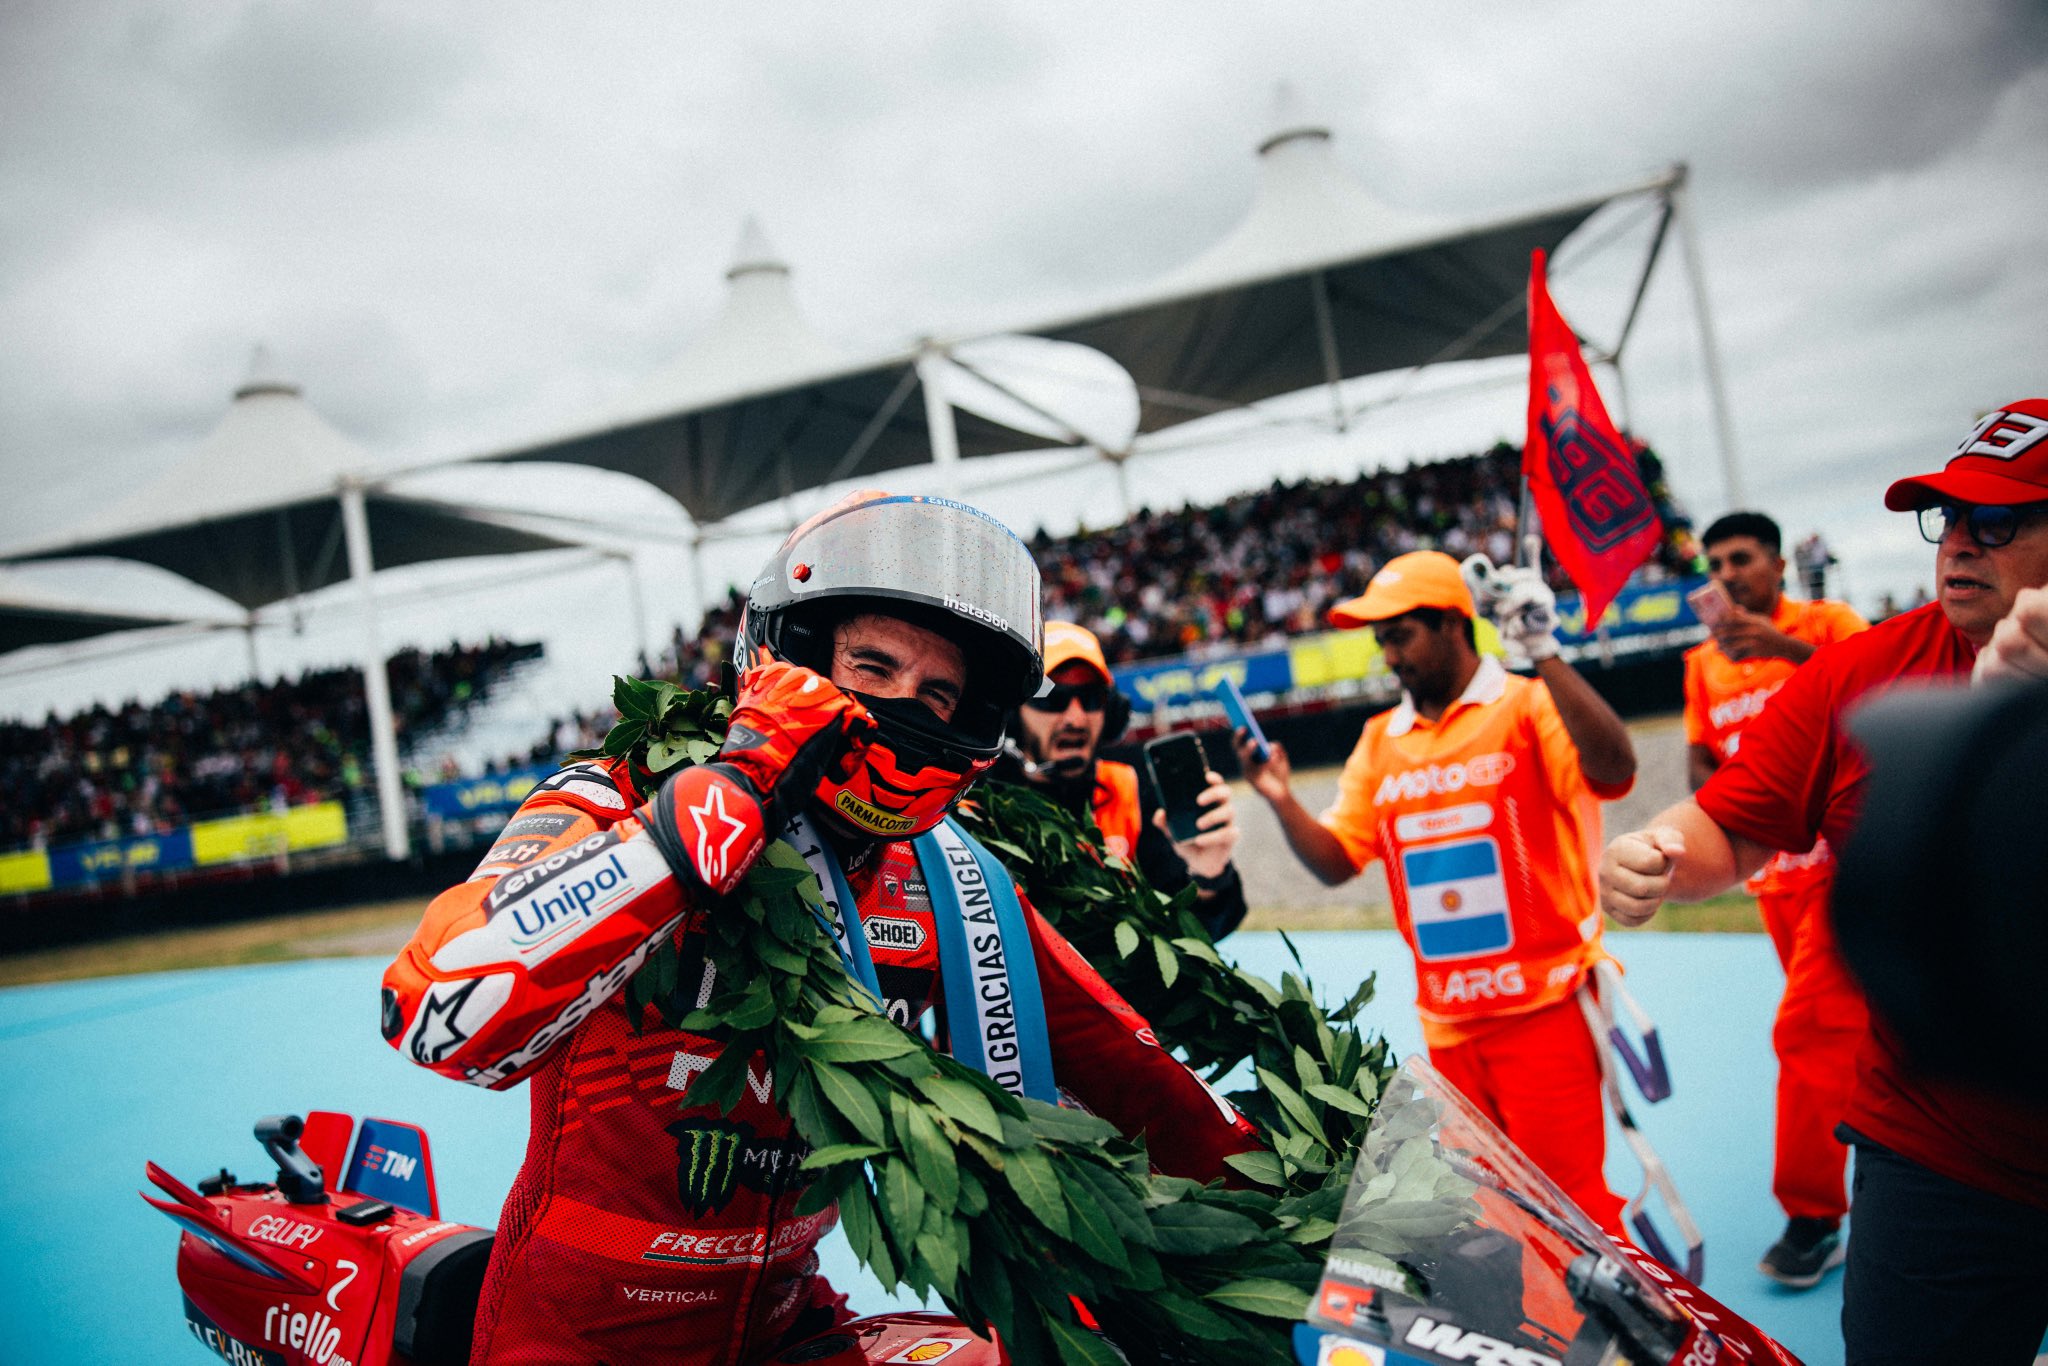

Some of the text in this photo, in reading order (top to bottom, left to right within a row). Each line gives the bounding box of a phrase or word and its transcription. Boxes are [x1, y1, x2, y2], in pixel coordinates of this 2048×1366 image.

[840, 794, 914, 831] PARMACOTTO
[488, 834, 607, 909] Lenovo
[945, 842, 996, 924] ÁNGEL
[512, 853, 629, 937] Unipol
[869, 921, 917, 944] SHOEI
[974, 933, 1018, 1063] GRACIAS
[1443, 961, 1525, 1004] ARG
[382, 1150, 417, 1181] TIM
[248, 1214, 324, 1249] GELLIFY
[623, 1287, 717, 1303] VERTICAL
[264, 1303, 341, 1364] riello
